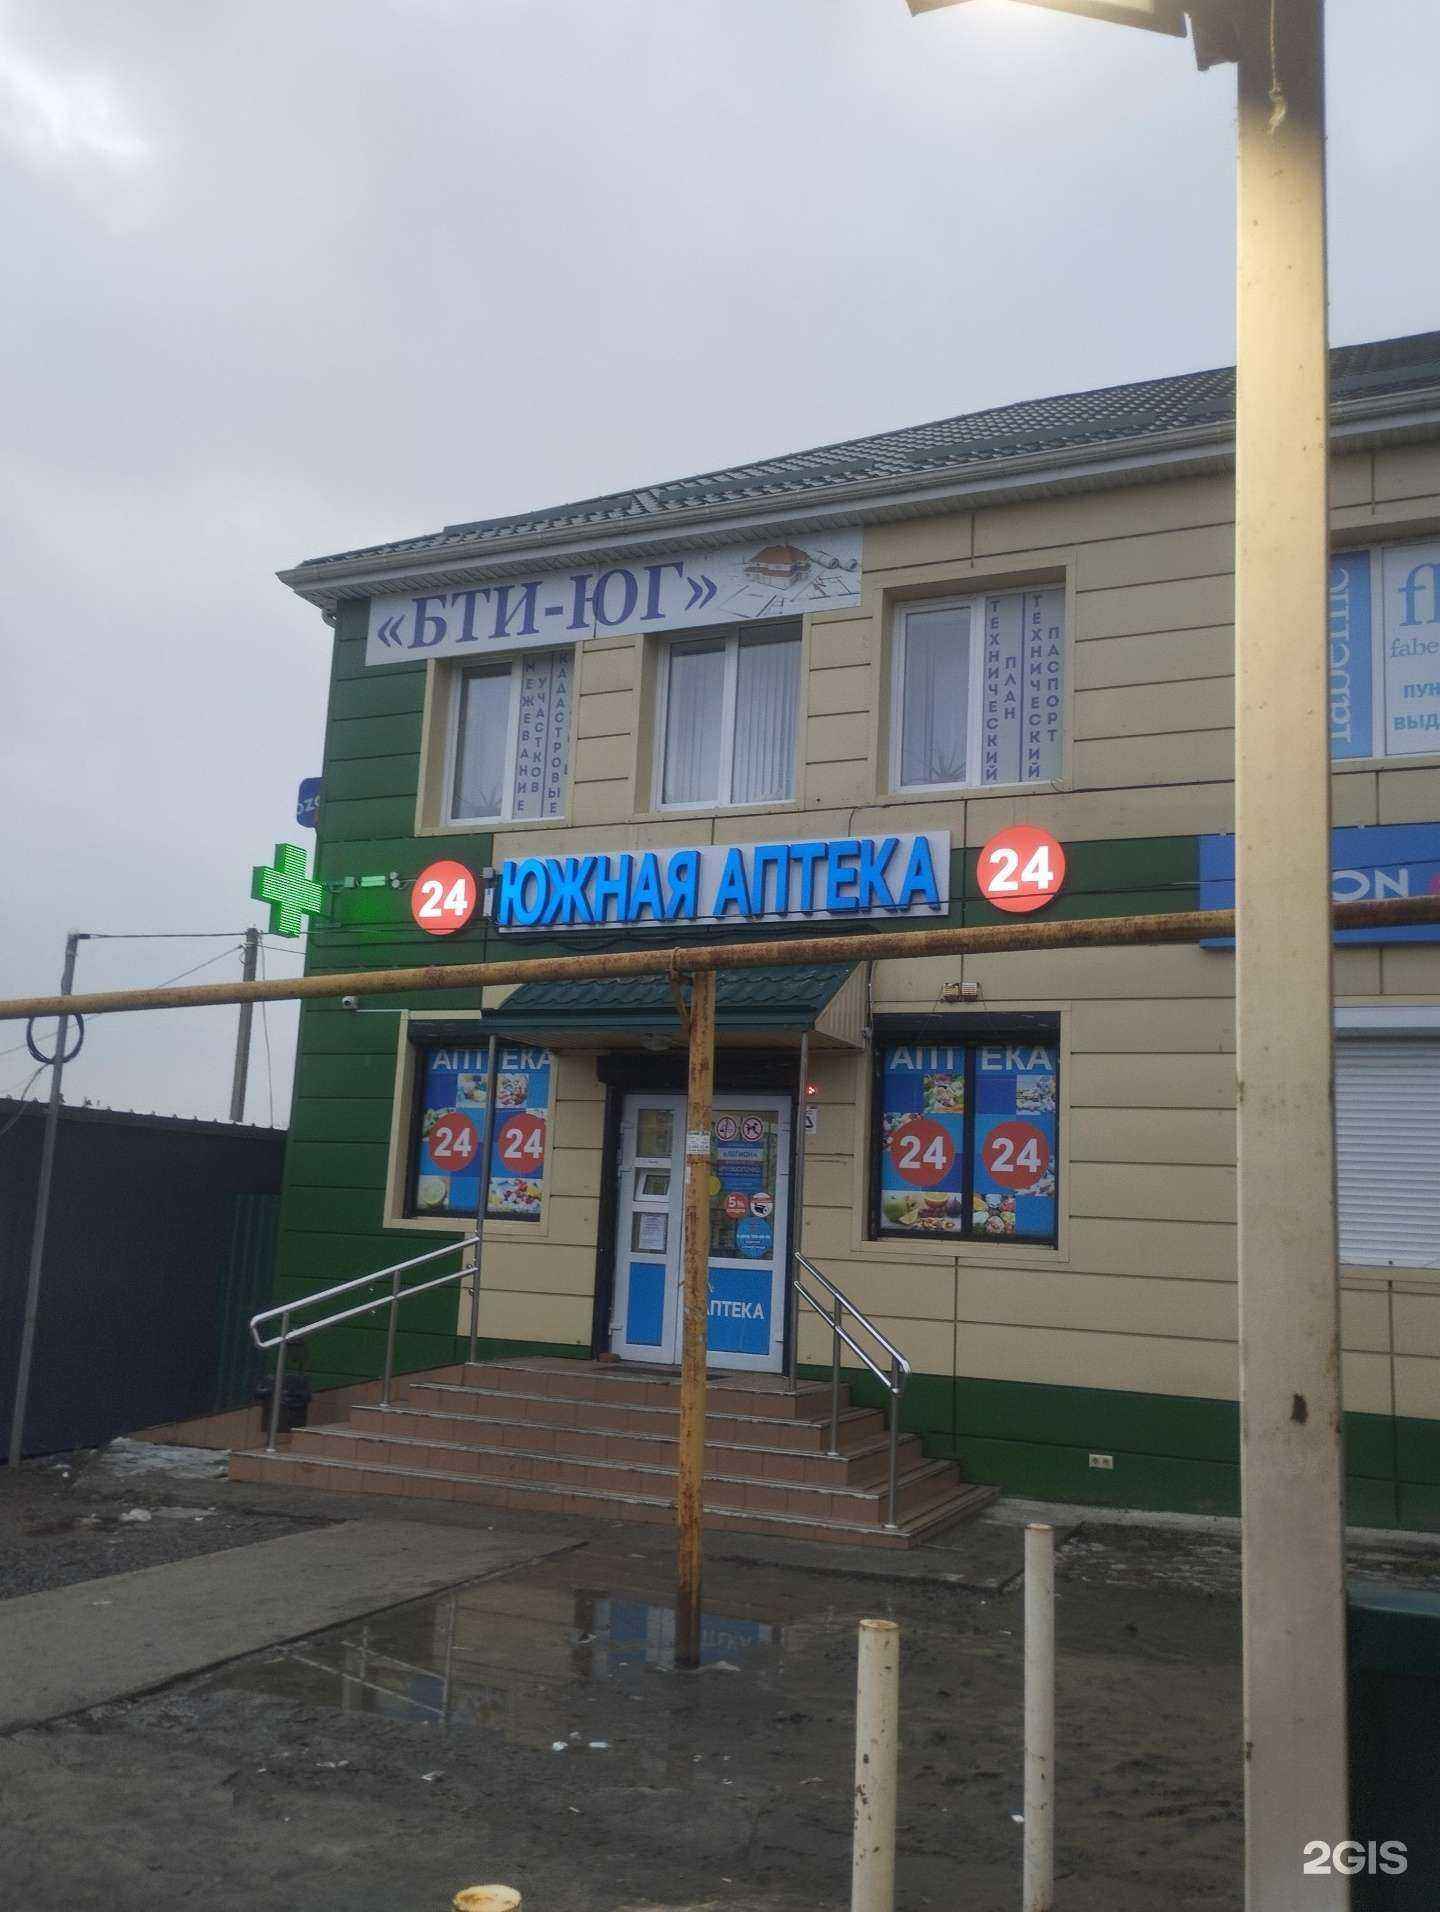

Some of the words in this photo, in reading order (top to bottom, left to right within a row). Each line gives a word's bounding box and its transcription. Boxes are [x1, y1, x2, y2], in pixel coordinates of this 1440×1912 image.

[377, 561, 718, 649] «БТИ-ЮГ»
[986, 601, 999, 780] ТЕХНИЧЕСКИЙ
[1004, 656, 1017, 719] ПЛАН
[1028, 595, 1043, 778] ТЕХНИЧЕСКИЙ
[1046, 626, 1060, 742] ПАСПОРТ
[517, 663, 535, 811] МЕЖЕВАНИЕ
[531, 677, 547, 793] УЧАСТКОВ
[548, 654, 569, 813] КАДАСТРОВЫЕ
[498, 850, 702, 927] ЮЖНАЯ
[712, 835, 942, 920] АПТЕКА
[988, 845, 1054, 892] 24
[418, 878, 468, 918] 24
[434, 1127, 472, 1158] 24
[504, 1128, 543, 1159] 24
[899, 1135, 947, 1170] 24
[990, 1137, 1041, 1173] 24
[707, 1300, 765, 1320] ПТЕКА
